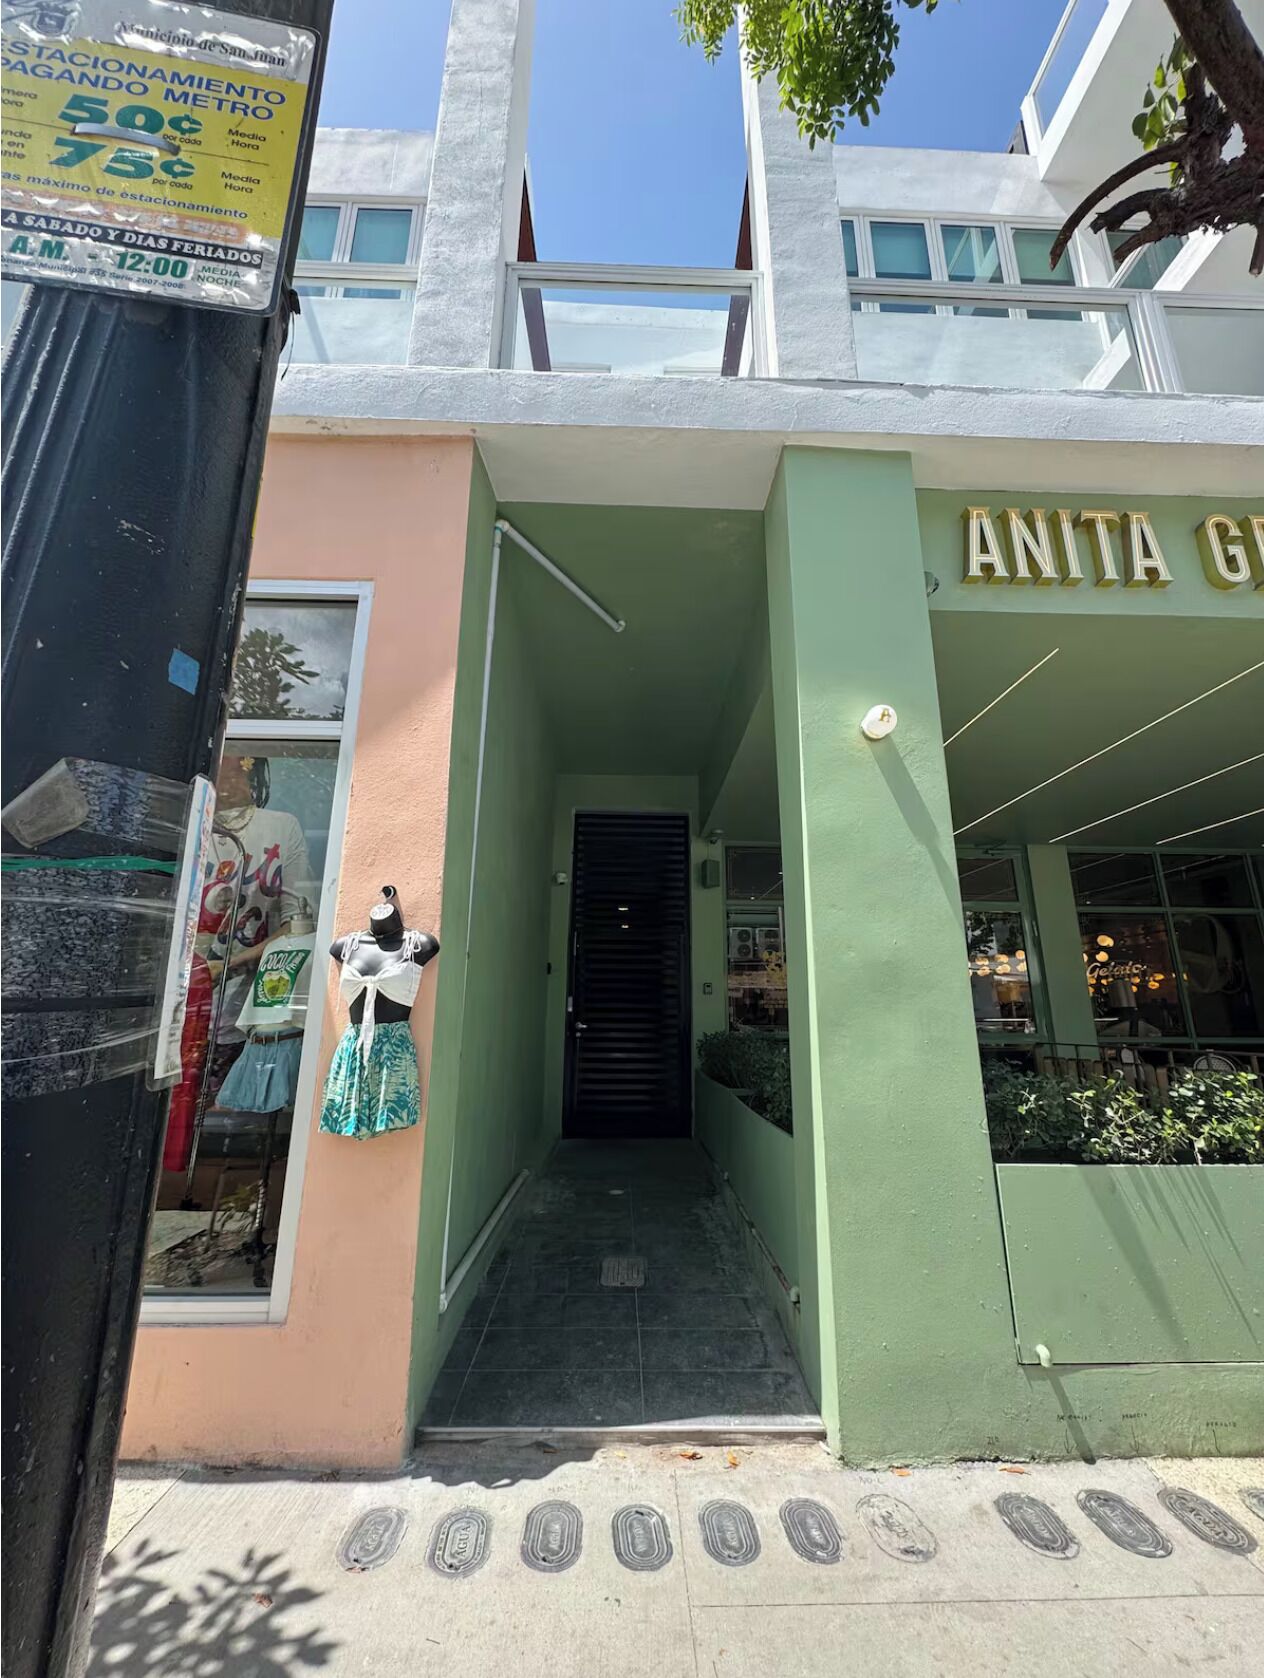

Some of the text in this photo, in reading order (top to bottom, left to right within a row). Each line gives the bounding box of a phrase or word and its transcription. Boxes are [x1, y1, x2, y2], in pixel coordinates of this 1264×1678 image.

[199, 38, 216, 52] de
[219, 42, 247, 58] San
[252, 49, 286, 67] Juan
[1, 38, 287, 105] STACIONAMIENTO
[1, 86, 38, 99] mera
[1, 96, 24, 107] ora
[163, 87, 274, 121] METRO
[162, 133, 202, 146] por cada
[227, 128, 267, 142] Media
[231, 138, 260, 151] Hora
[169, 179, 193, 191] cada
[221, 171, 261, 185] Media
[224, 182, 253, 194] Hora
[26, 174, 91, 193] máximo
[96, 186, 115, 197] de
[120, 190, 248, 219] estacionamiento
[23, 214, 102, 237] SABADO
[107, 228, 121, 241] Y
[123, 233, 168, 250] DIAS
[171, 240, 262, 265] FERIADOS
[116, 251, 188, 279] 12:00
[201, 265, 241, 279] MEDIA
[196, 275, 242, 289] NOCHE
[961, 505, 1174, 589] ANITA
[457, 1524, 472, 1558] AGUA
